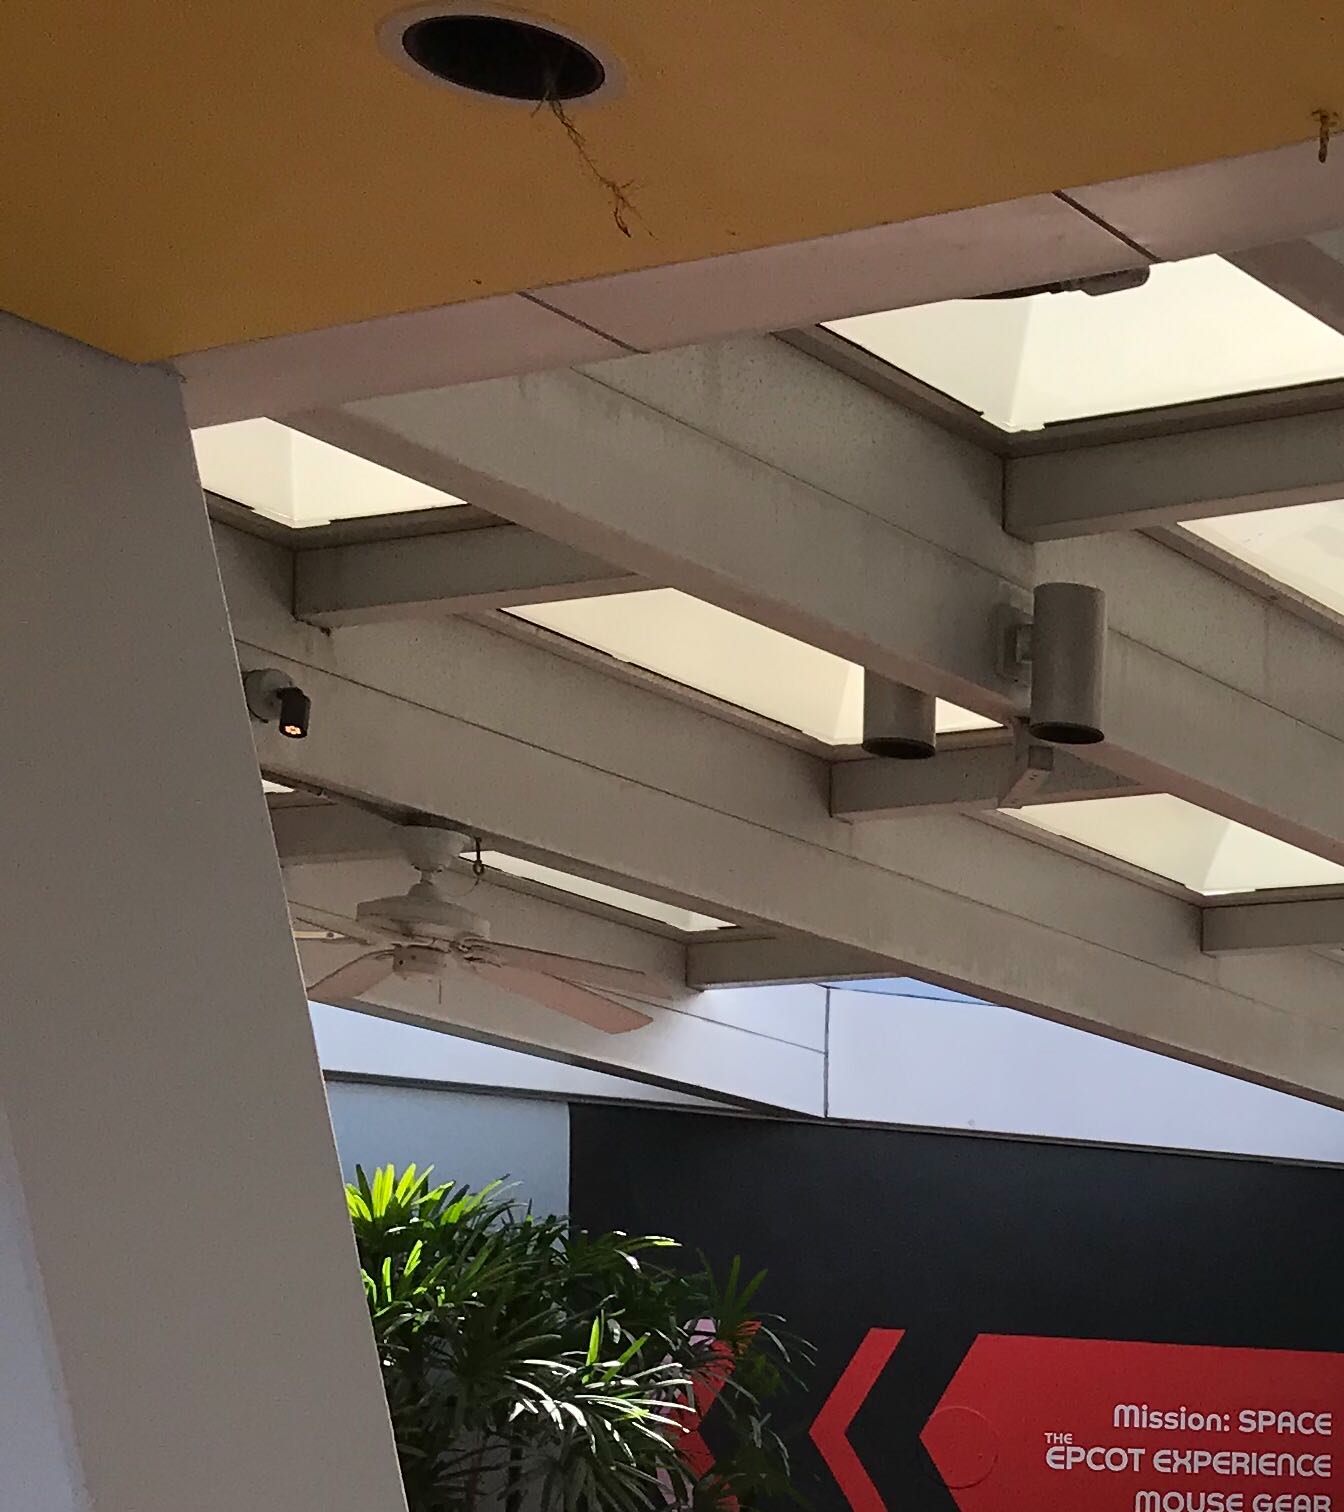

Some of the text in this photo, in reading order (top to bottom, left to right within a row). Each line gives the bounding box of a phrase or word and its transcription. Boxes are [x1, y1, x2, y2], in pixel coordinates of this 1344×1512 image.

[1113, 1404, 1332, 1435] Mission: SPACE
[1044, 1432, 1073, 1444] THE
[1045, 1446, 1331, 1477] EPCOT EXPERIENCE
